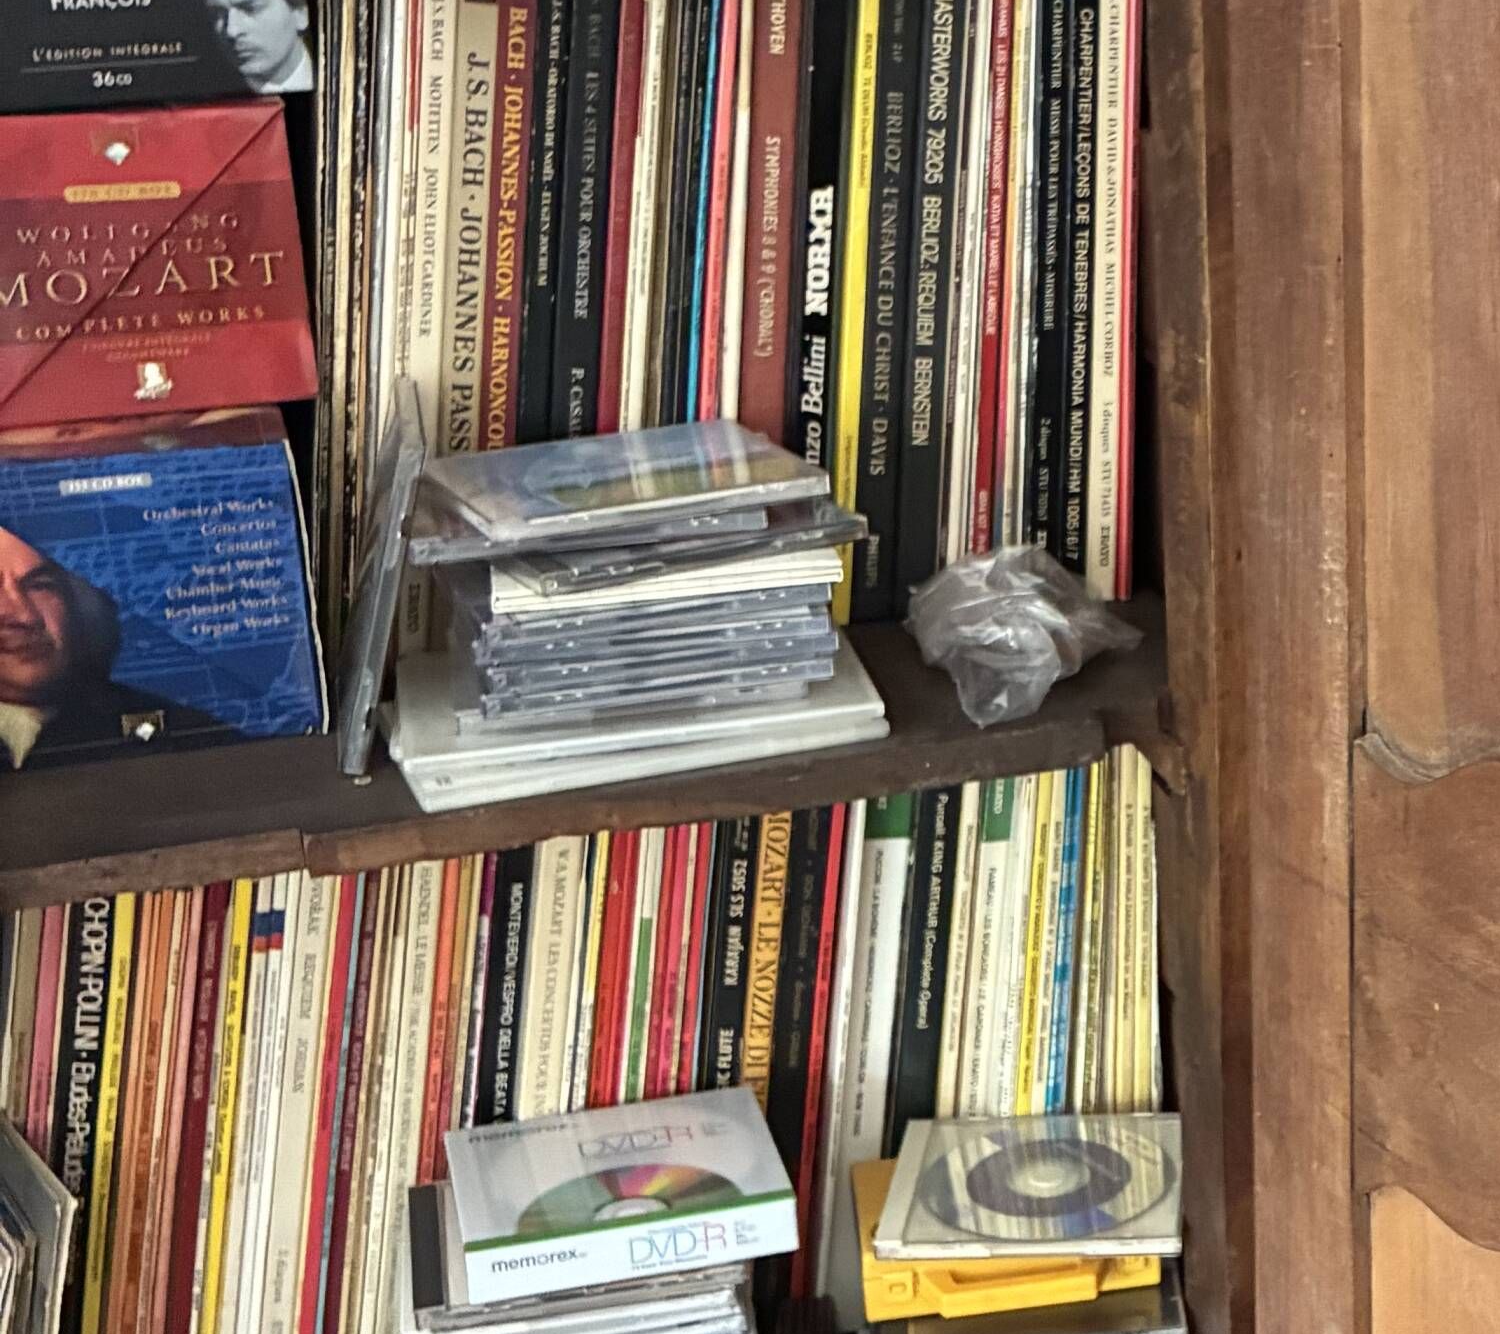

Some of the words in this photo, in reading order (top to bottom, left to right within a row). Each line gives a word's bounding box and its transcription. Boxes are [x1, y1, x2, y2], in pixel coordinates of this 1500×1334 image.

[430, 19, 444, 60] BACH
[507, 7, 529, 70] BACH
[548, 25, 561, 59] BACH
[463, 106, 489, 186] BACH
[885, 91, 904, 173] BERLIOZ
[1105, 118, 1119, 162] DAVID
[924, 127, 949, 184] 79205
[425, 168, 439, 209] JOHN
[495, 85, 524, 300] JOHANNES-PASSION
[580, 177, 595, 222] POUR
[761, 136, 781, 232] SYMPHONIES
[1076, 203, 1091, 225] DE
[878, 186, 899, 290] L'ENFANCE
[0, 251, 283, 307] MOZART
[453, 207, 482, 371] JOHANNES
[573, 226, 592, 319] ORCHESTRE
[1104, 262, 1117, 317] MICHEL
[177, 305, 266, 325] WORKS
[419, 259, 434, 338] GARDINER
[876, 295, 894, 327] DU
[914, 272, 939, 346] REQUIEM
[872, 331, 892, 402] CHRIST
[1102, 322, 1115, 378] CORBOZ
[801, 335, 827, 412] Bellini
[910, 356, 935, 447] BERNSTEIN
[869, 417, 890, 476] DAVIS
[143, 503, 223, 521] Orchestral
[226, 498, 273, 512] Works
[200, 519, 276, 535] Concertos
[215, 538, 280, 554] Cantatas
[236, 558, 282, 571] Works
[164, 601, 236, 620] Keyboard
[240, 596, 287, 610] Works
[166, 582, 234, 600] Chamber
[243, 614, 289, 628] Works
[930, 841, 944, 873] KING
[927, 875, 942, 929] ARTHUR
[724, 924, 744, 985] KARAJAN
[758, 921, 780, 956] LE
[920, 930, 937, 988] (Complete
[749, 959, 777, 1039] NOZZE
[916, 990, 932, 1030] Opera)
[496, 1028, 512, 1068] DELLA
[718, 1029, 734, 1070] FLUTE
[747, 1045, 769, 1072] DI
[493, 1072, 509, 1116] BEATA
[491, 1247, 579, 1275] memorex
